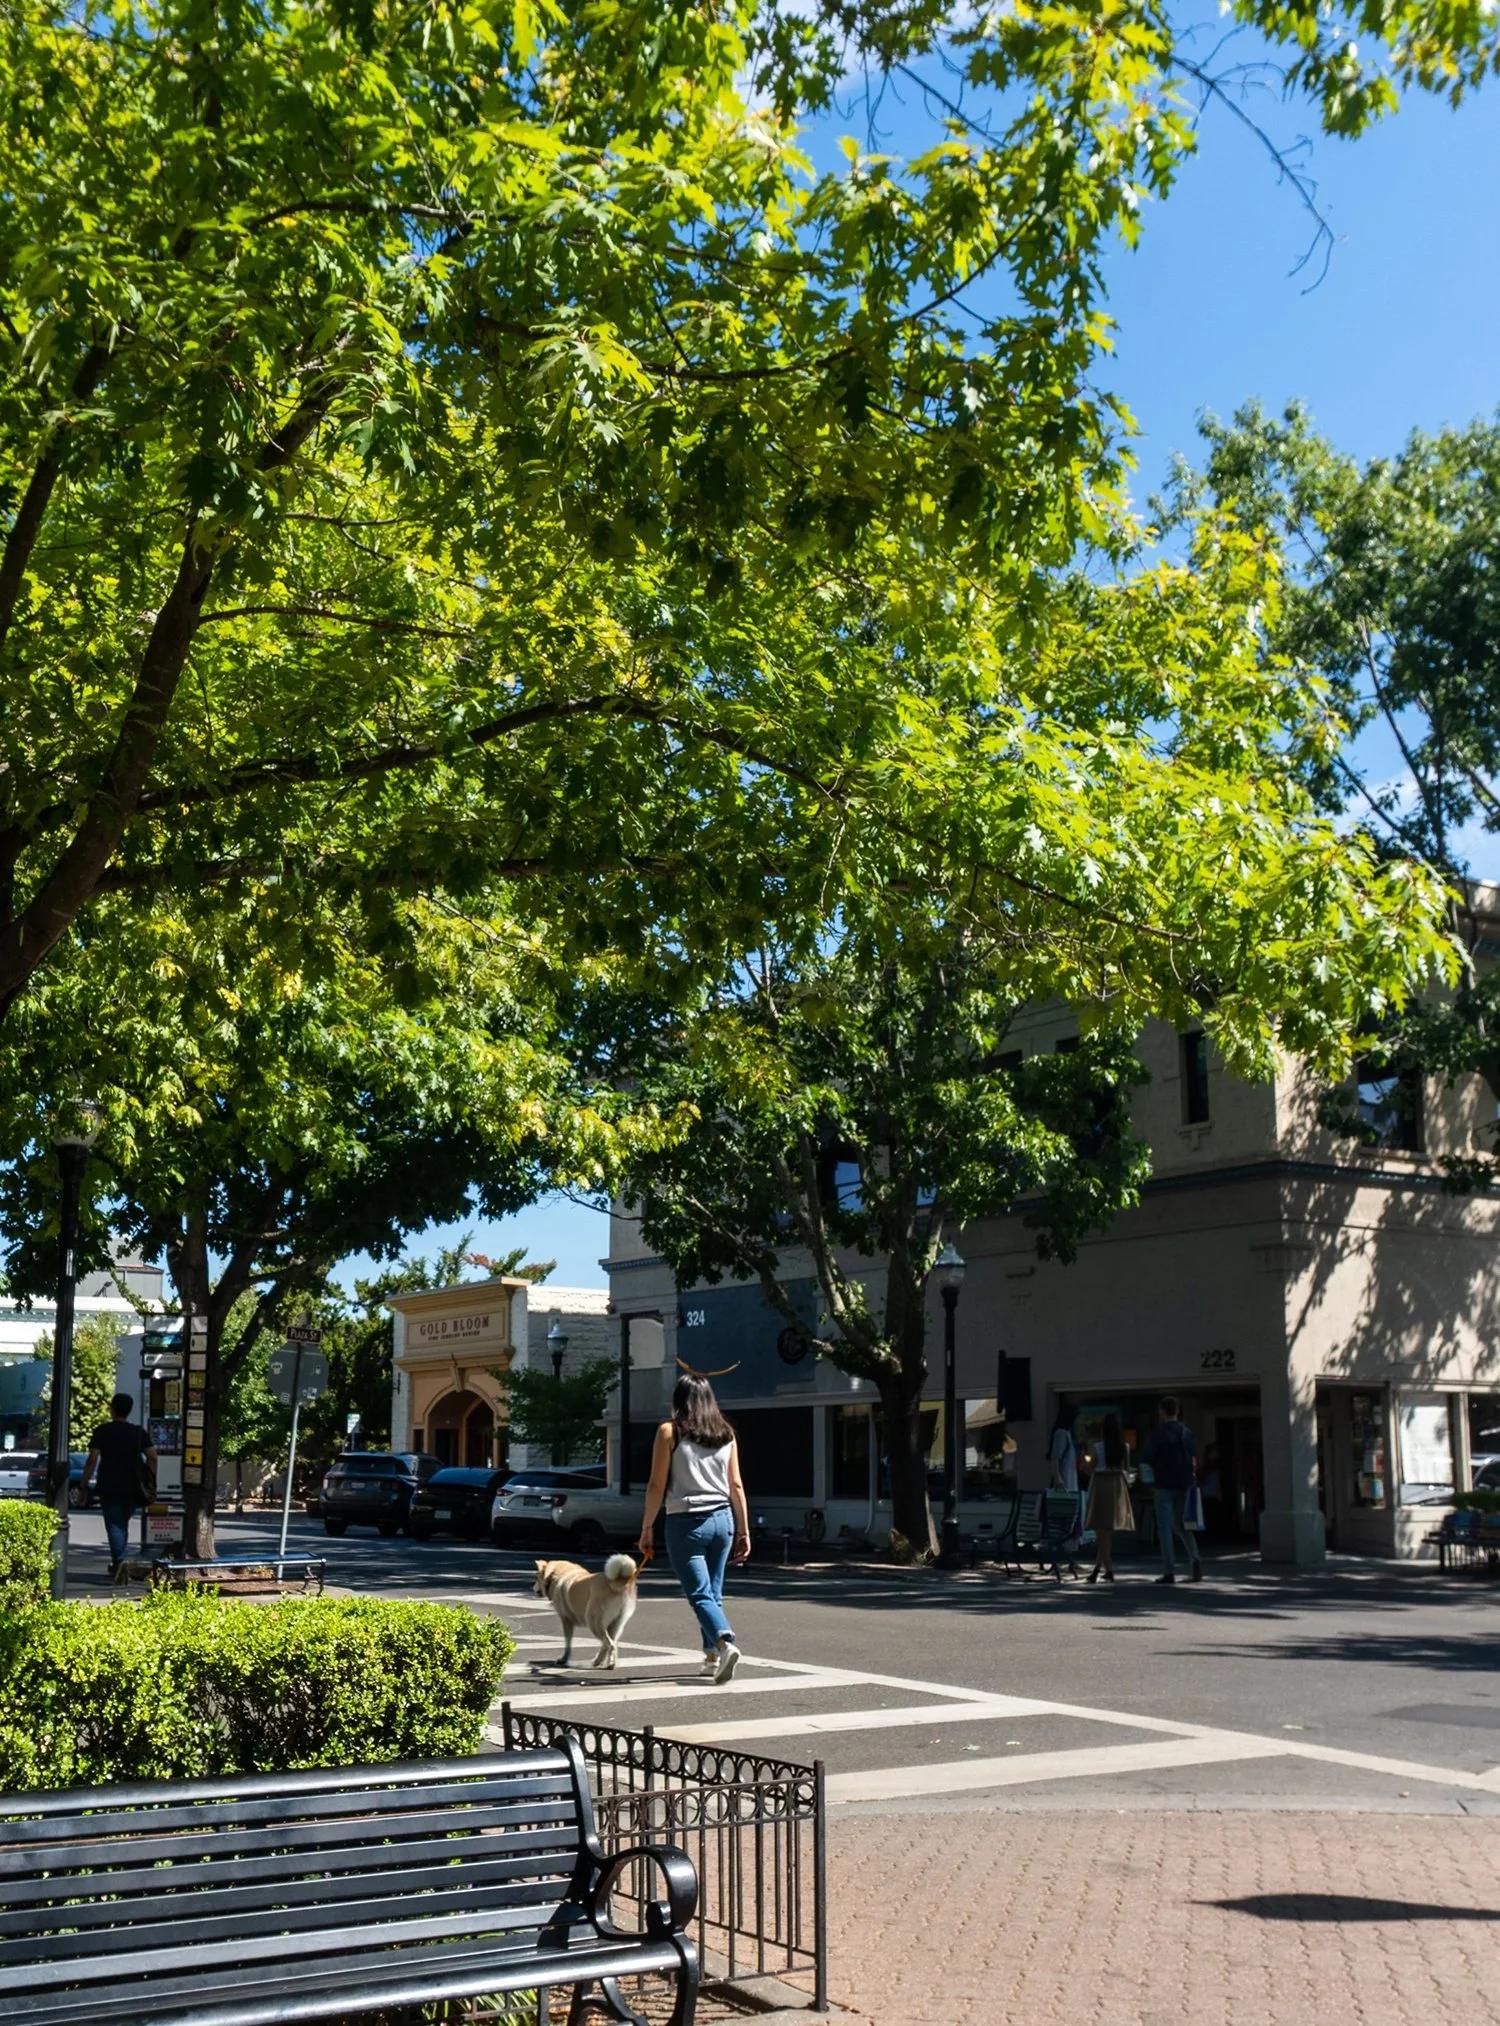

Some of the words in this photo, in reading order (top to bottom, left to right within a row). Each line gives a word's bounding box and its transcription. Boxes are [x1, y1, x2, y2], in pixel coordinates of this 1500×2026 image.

[420, 1322, 447, 1336] GOLD
[453, 1316, 489, 1332] BLOOM
[686, 1310, 705, 1327] 324
[1200, 1349, 1236, 1368] 222
